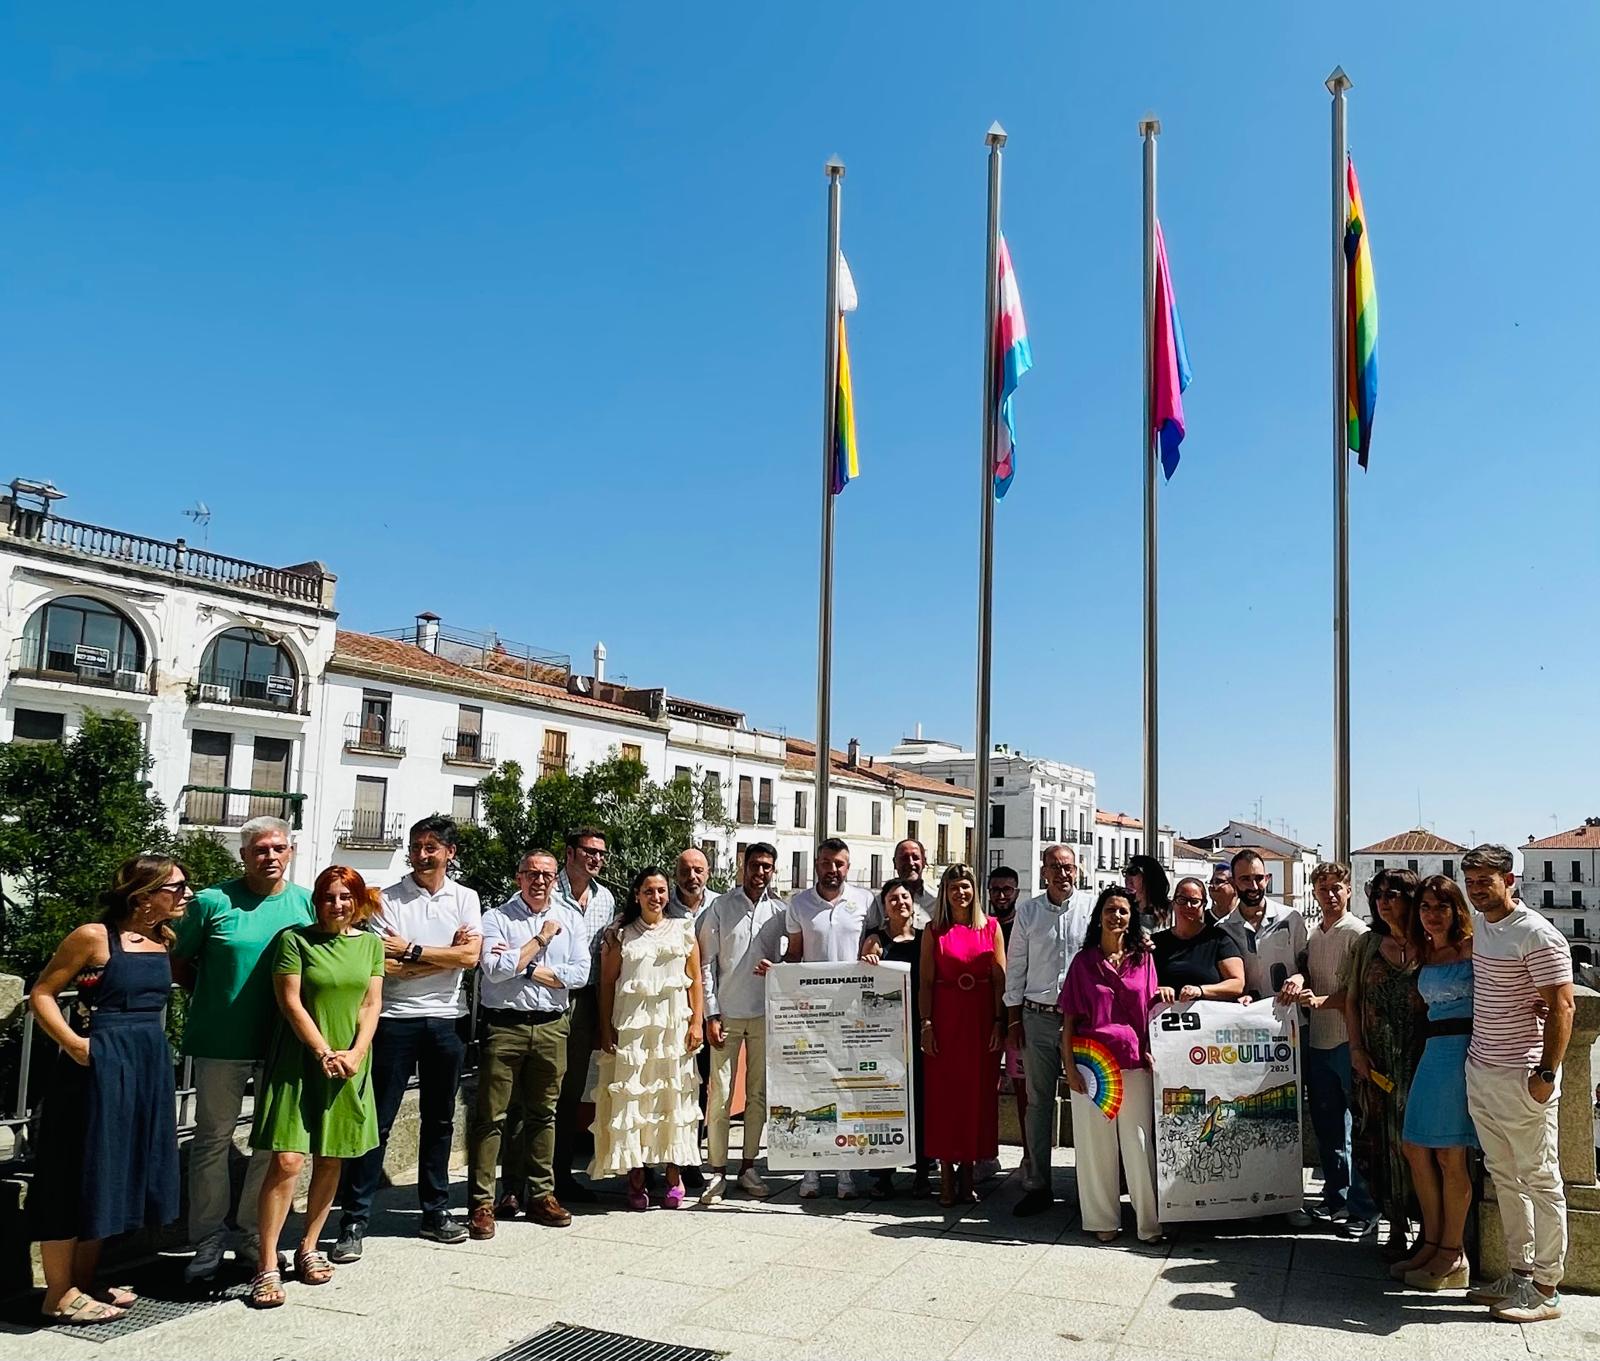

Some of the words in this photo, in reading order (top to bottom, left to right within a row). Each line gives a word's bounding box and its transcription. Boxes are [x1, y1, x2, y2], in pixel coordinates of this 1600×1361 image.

[800, 975, 874, 986] PROGRAMACIÓN
[1161, 1012, 1201, 1031] 29
[1189, 1044, 1292, 1065] ORGULLO
[860, 1062, 877, 1070] 29
[835, 1133, 905, 1147] ORGULLO
